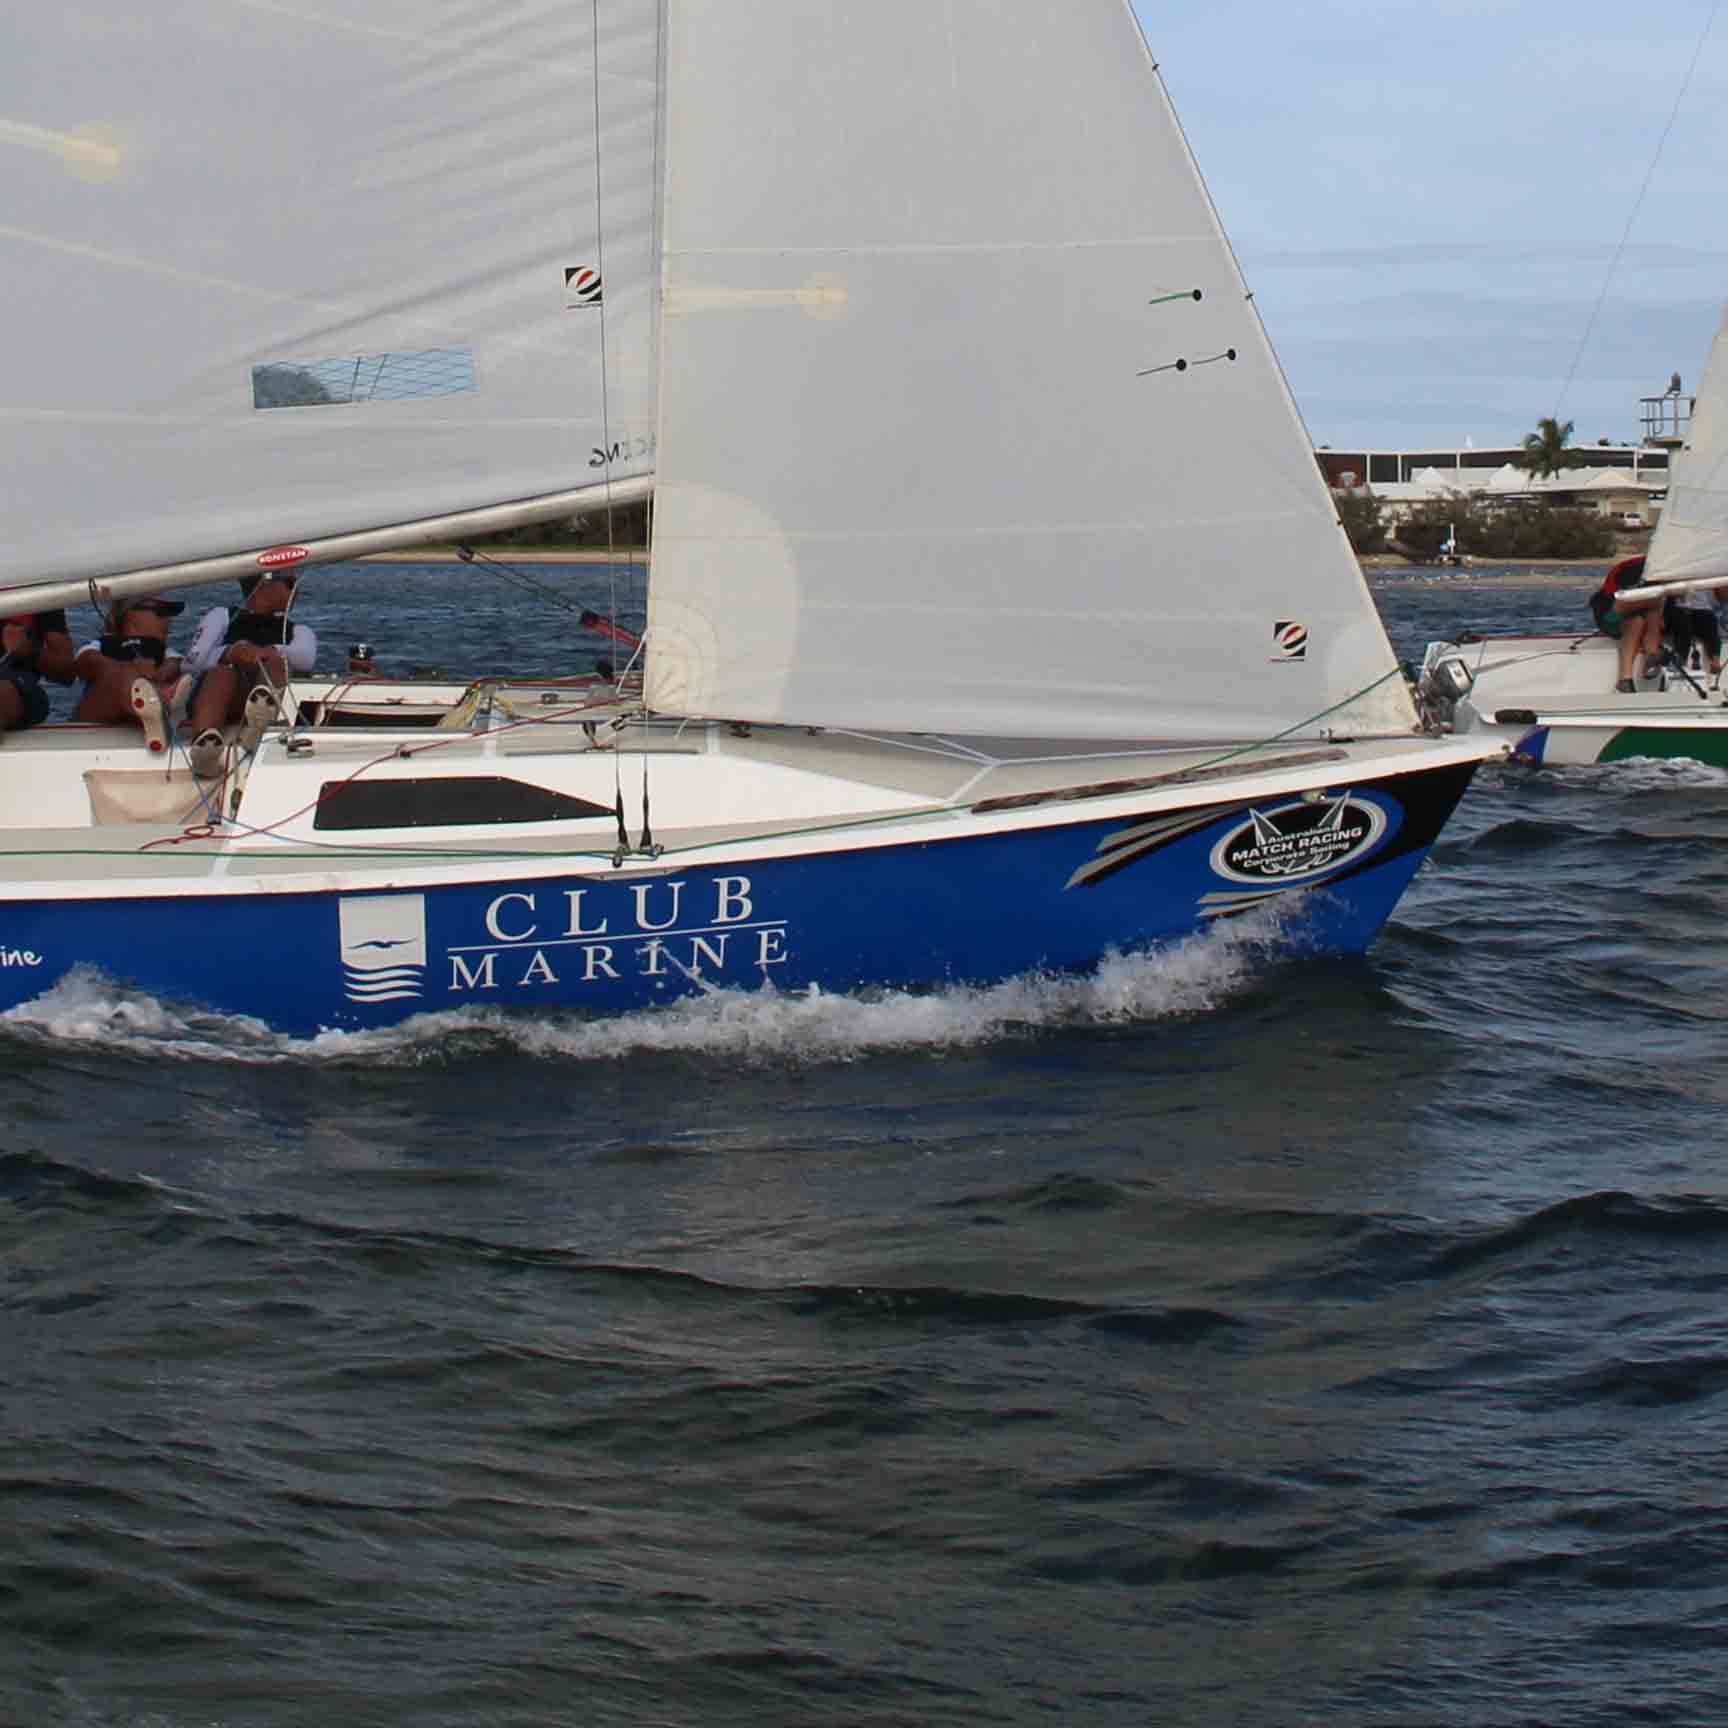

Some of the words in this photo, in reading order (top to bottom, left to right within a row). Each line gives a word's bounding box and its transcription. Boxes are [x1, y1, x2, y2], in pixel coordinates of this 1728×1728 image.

[1232, 841, 1293, 862] MATCH
[1298, 826, 1362, 849] RACING
[485, 875, 753, 941] CLUB
[447, 928, 788, 990] MARINE
